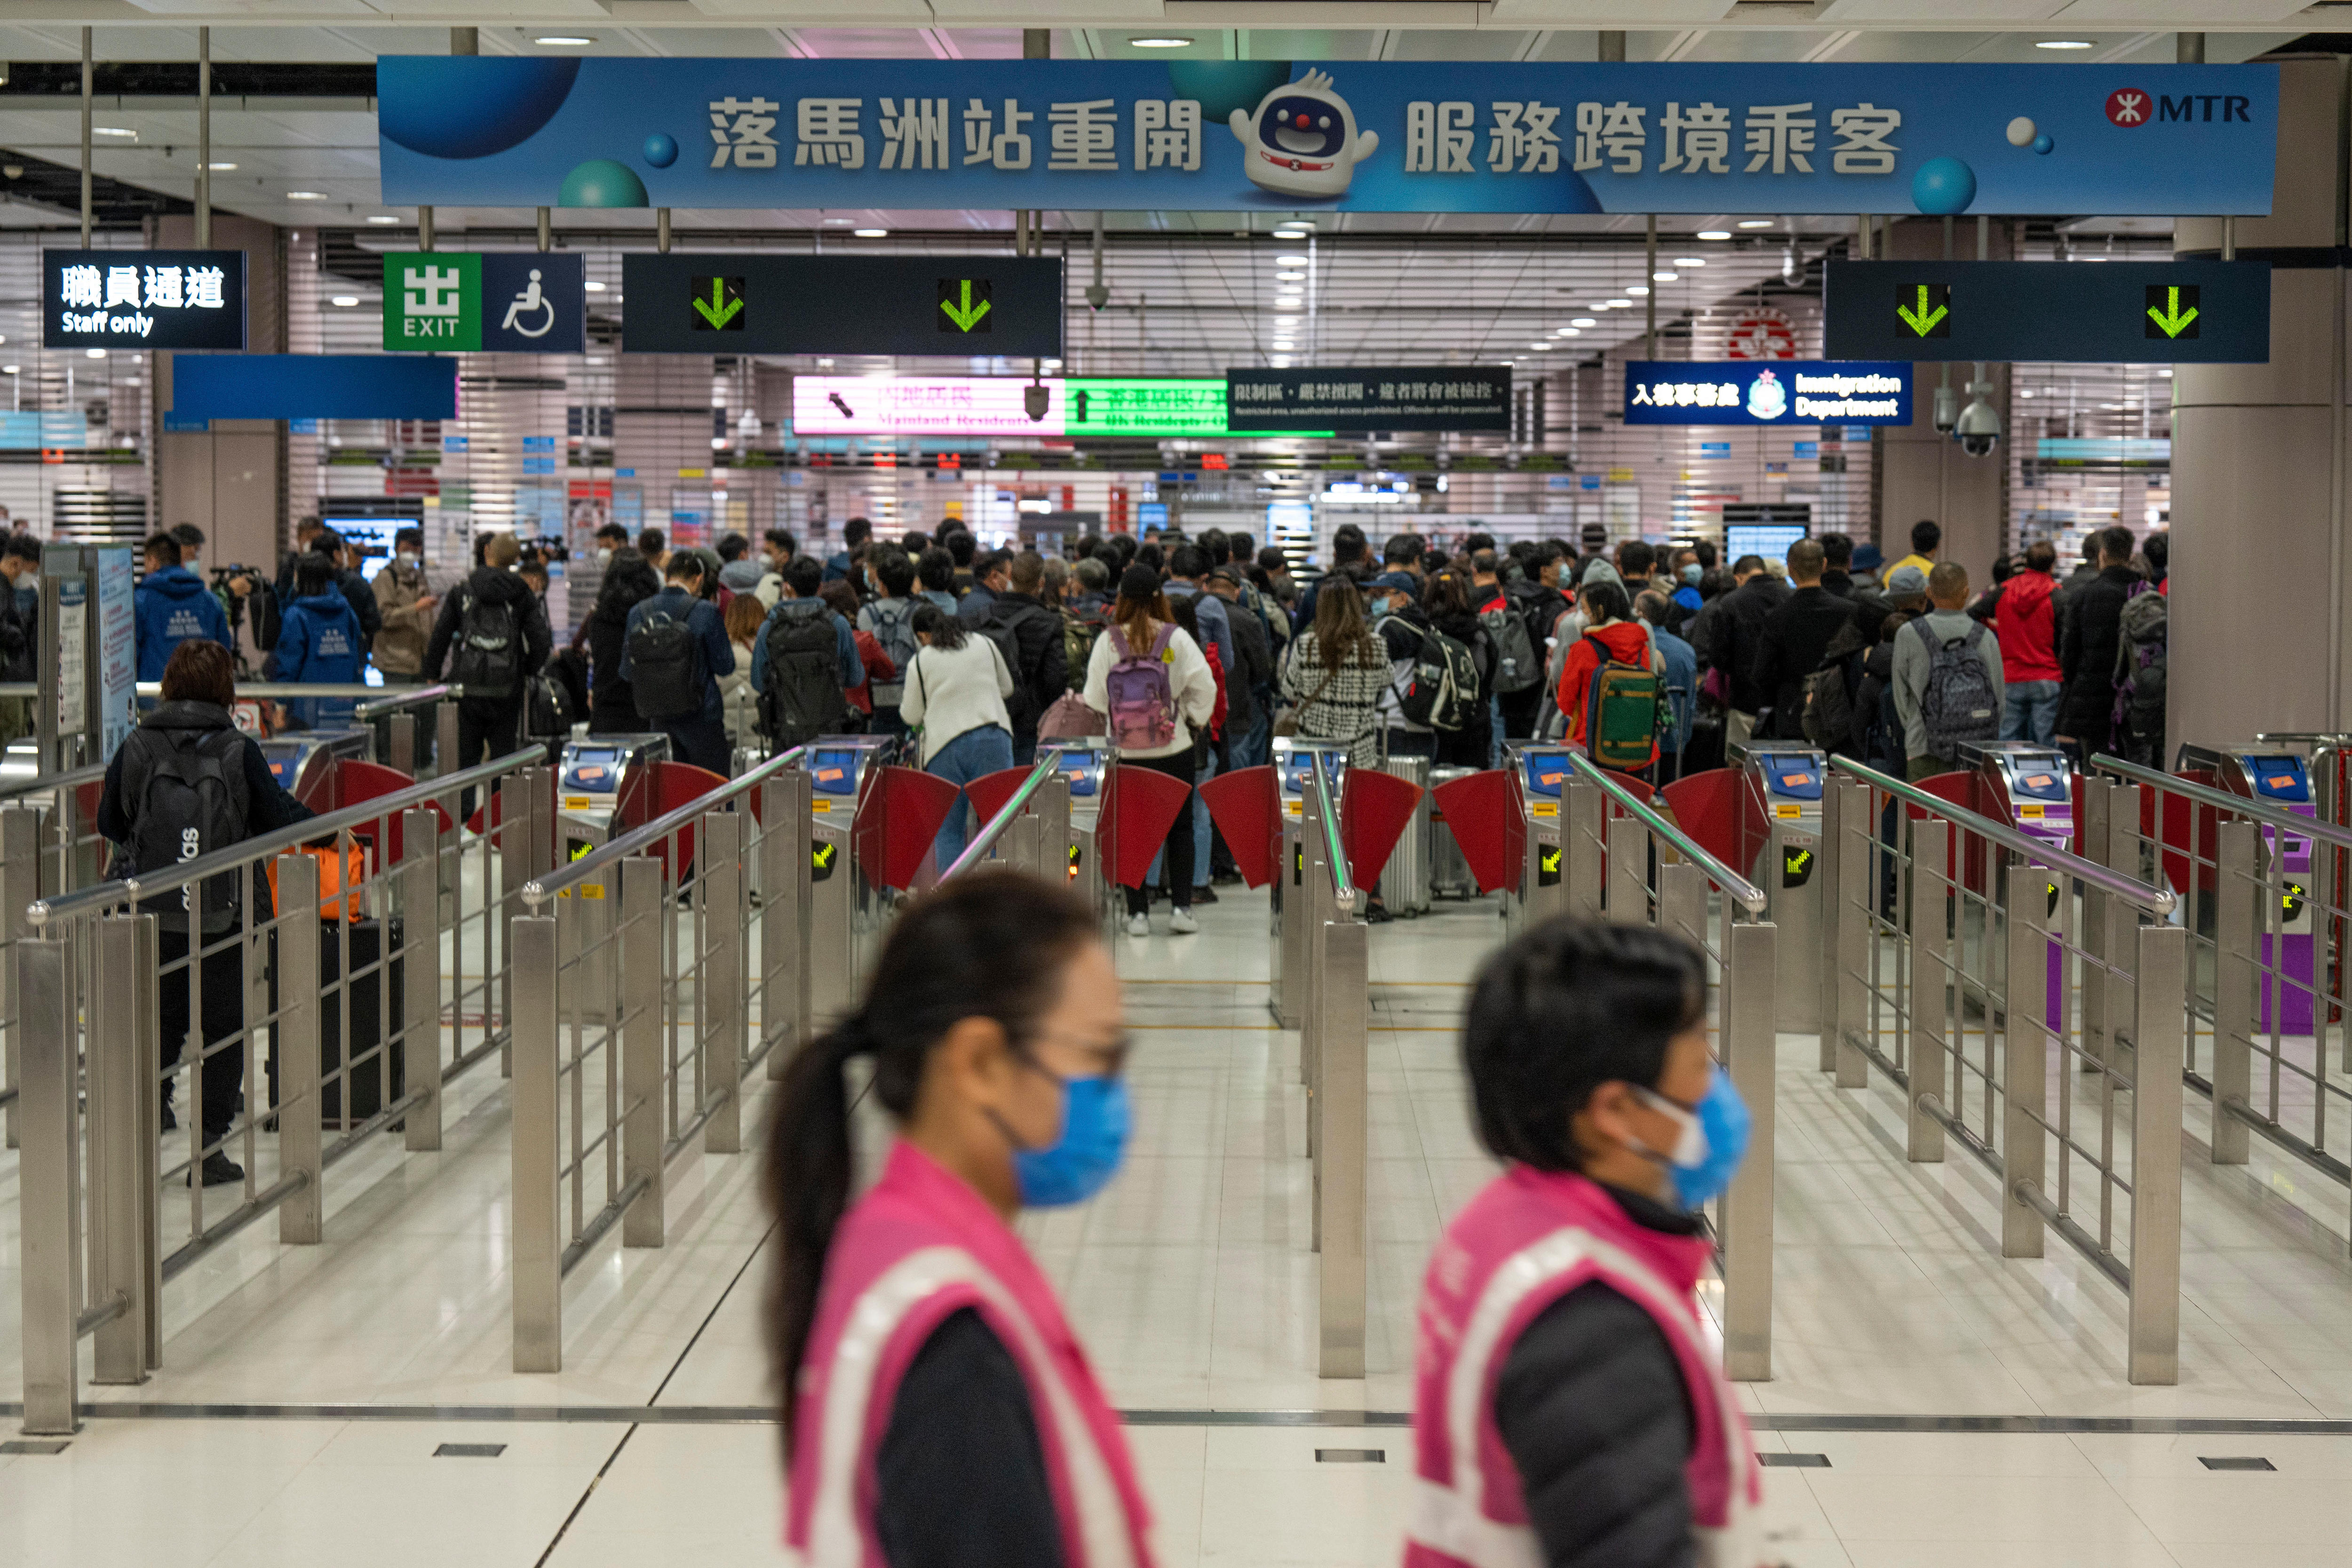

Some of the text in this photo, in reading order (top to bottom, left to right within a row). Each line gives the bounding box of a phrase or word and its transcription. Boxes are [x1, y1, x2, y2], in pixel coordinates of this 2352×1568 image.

[2160, 95, 2251, 122] MTR
[709, 96, 1902, 174] 落馬洲站重開 服務跨境乘客
[61, 265, 225, 308] 職員通道
[404, 265, 459, 316] 出
[62, 310, 154, 338] Staff only
[404, 318, 459, 336] EXIT
[1796, 373, 1901, 397] Immigration
[878, 413, 1029, 425] Mainland Residents
[1795, 397, 1899, 420] Department
